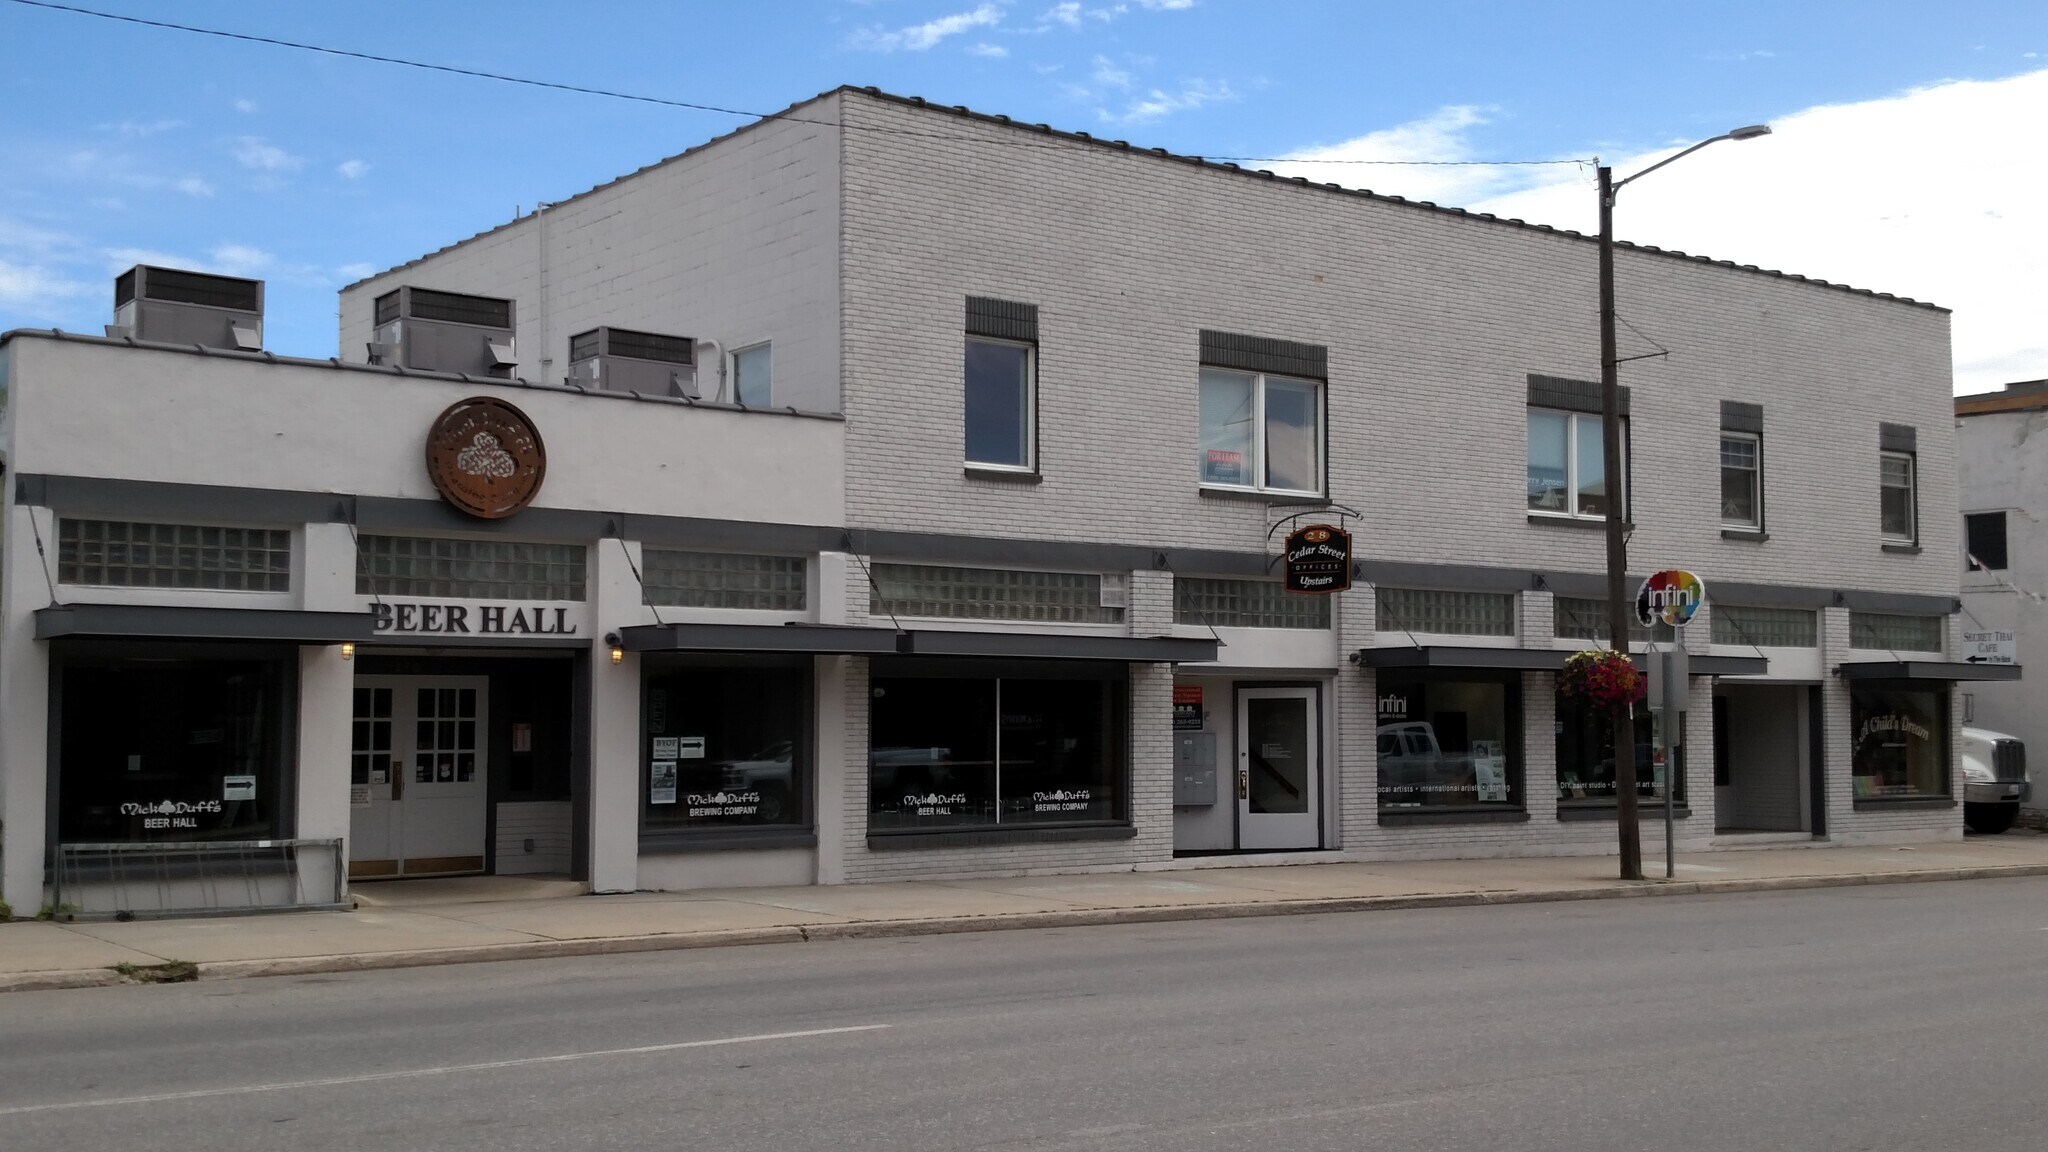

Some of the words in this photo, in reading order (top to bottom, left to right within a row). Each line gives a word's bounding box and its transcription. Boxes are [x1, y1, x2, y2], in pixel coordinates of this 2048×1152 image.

[1307, 530, 1326, 540] 28
[1288, 545, 1316, 562] Cedar
[1317, 544, 1346, 560] Street
[1299, 576, 1333, 588] Upstairs
[1648, 584, 1694, 607] infini
[368, 603, 470, 633] BEER
[479, 606, 577, 634] HALL
[1963, 632, 1992, 642] SECRET
[1994, 631, 2013, 641] THAI
[1978, 643, 1998, 653] CAFE
[1378, 694, 1407, 713] infini
[1870, 714, 1899, 733] Child's
[1901, 714, 1930, 741] Dream
[1393, 785, 1413, 793] artists
[1420, 784, 1460, 793] international
[1588, 781, 1607, 789] studio
[687, 793, 716, 806] Mick
[726, 792, 760, 804] Duff's
[903, 794, 928, 806] Mick
[937, 793, 967, 805] Duff's
[1033, 791, 1055, 802] Mick
[1063, 789, 1091, 801] Duff's
[120, 802, 160, 816] Mick
[175, 800, 222, 815] Duff's
[689, 807, 722, 817] BREWING
[724, 806, 758, 815] COMPANY
[918, 807, 935, 816] BEER
[936, 807, 951, 815] HALL
[1034, 803, 1061, 812] BREWING
[1061, 802, 1088, 811] COMPANY
[144, 818, 170, 829] BEER
[173, 817, 197, 828] HALL
